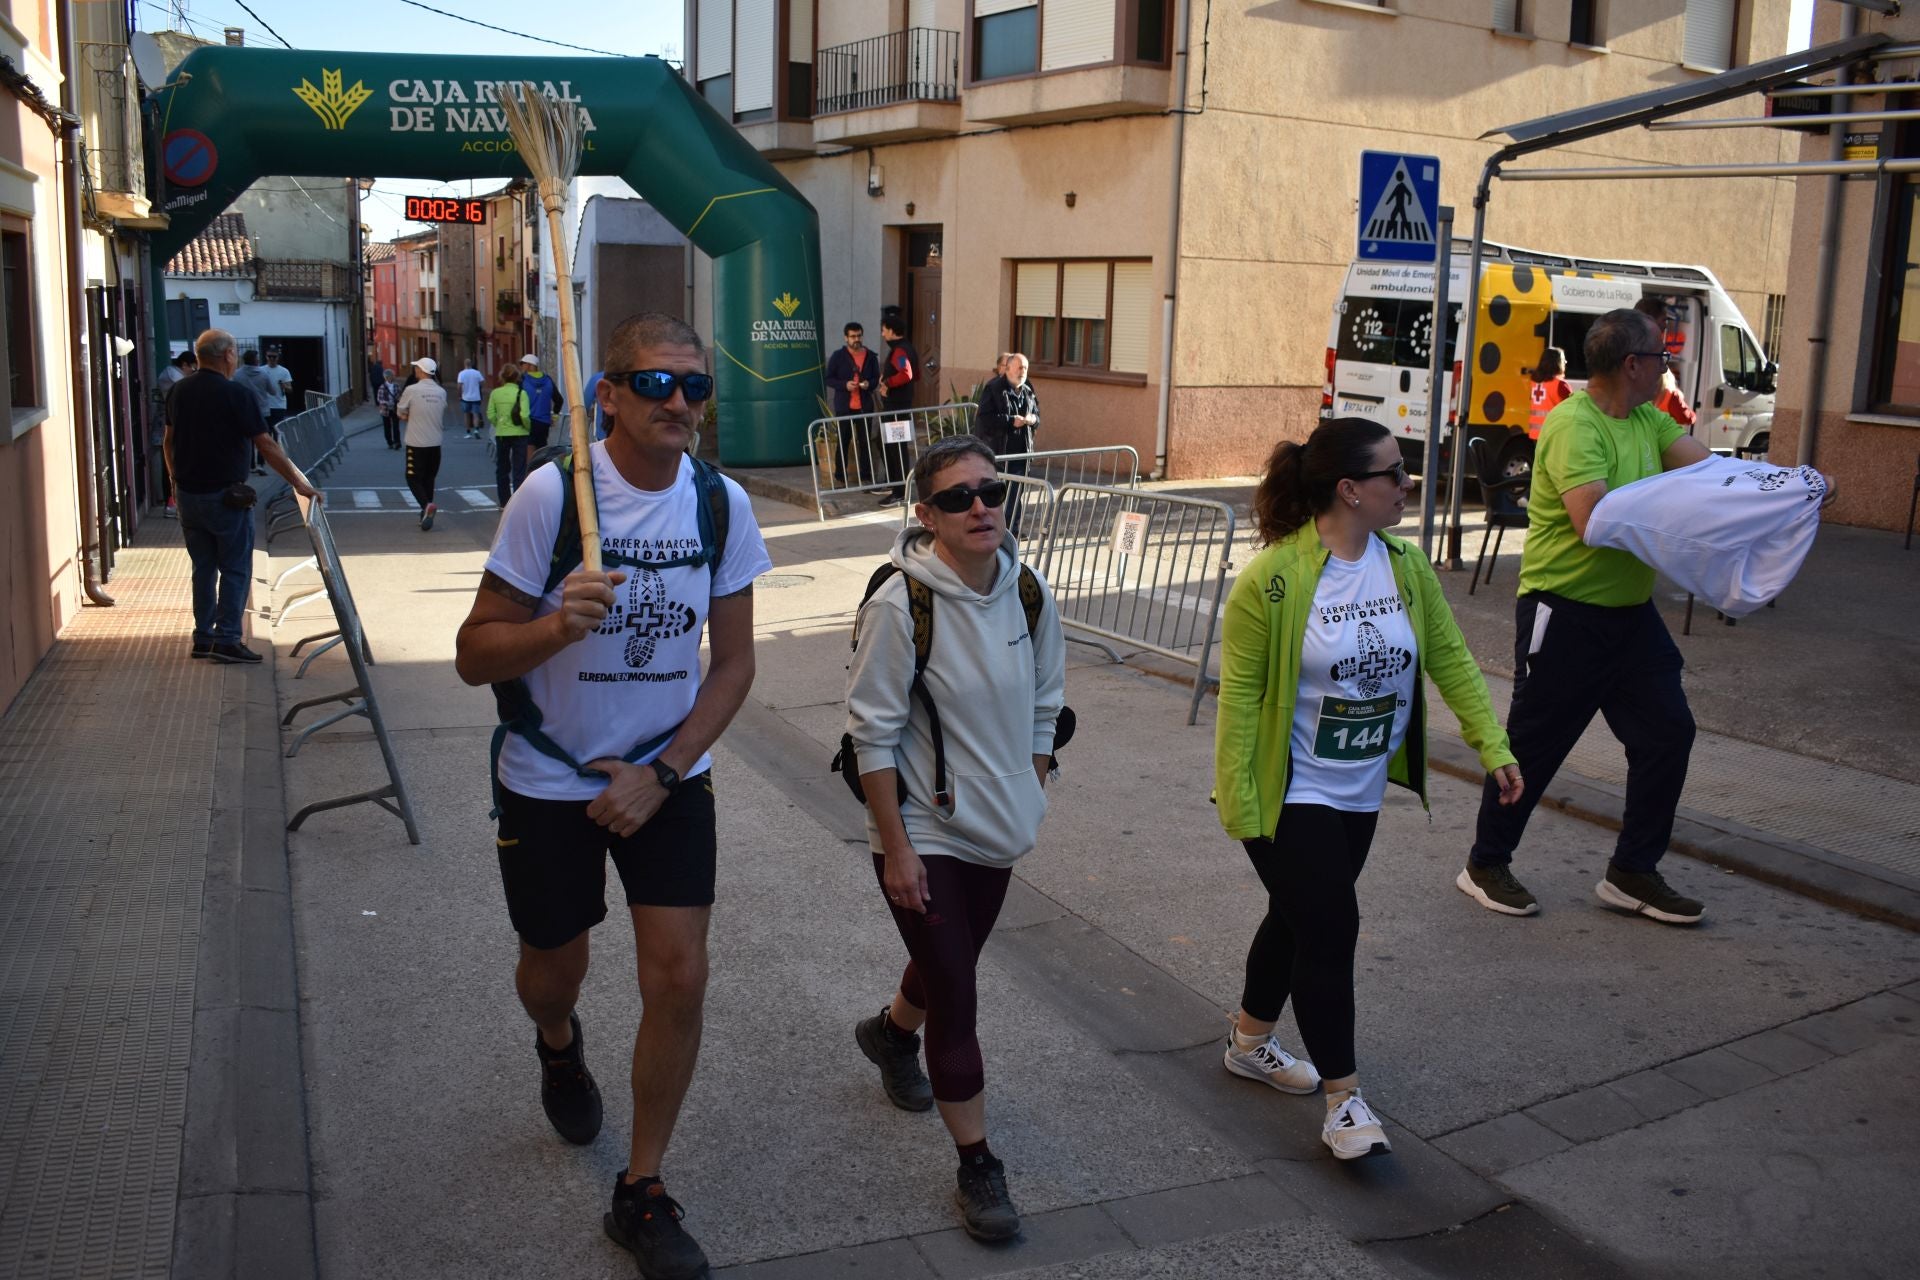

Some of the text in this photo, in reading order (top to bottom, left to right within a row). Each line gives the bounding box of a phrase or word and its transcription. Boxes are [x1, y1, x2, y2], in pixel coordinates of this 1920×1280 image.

[389, 79, 470, 106] CAJA
[389, 107, 597, 132] DE NAVA
[461, 138, 519, 153] ACCIÓ
[408, 198, 482, 222] 00:02:16
[1357, 268, 1381, 277] Unidad
[1381, 268, 1400, 278] Móvil
[1401, 267, 1412, 279] de
[1561, 285, 1633, 302] Gobierno de La Rioja
[752, 320, 816, 332] CAJA RURAL
[1364, 320, 1383, 336] 112
[751, 331, 818, 342] DE NAVARRA
[601, 537, 699, 550] ARRERA-MARCHA
[1320, 594, 1401, 615] CARRERA-MARCHA
[1322, 603, 1404, 625] SOLIDARIA
[1332, 723, 1385, 751] 144
